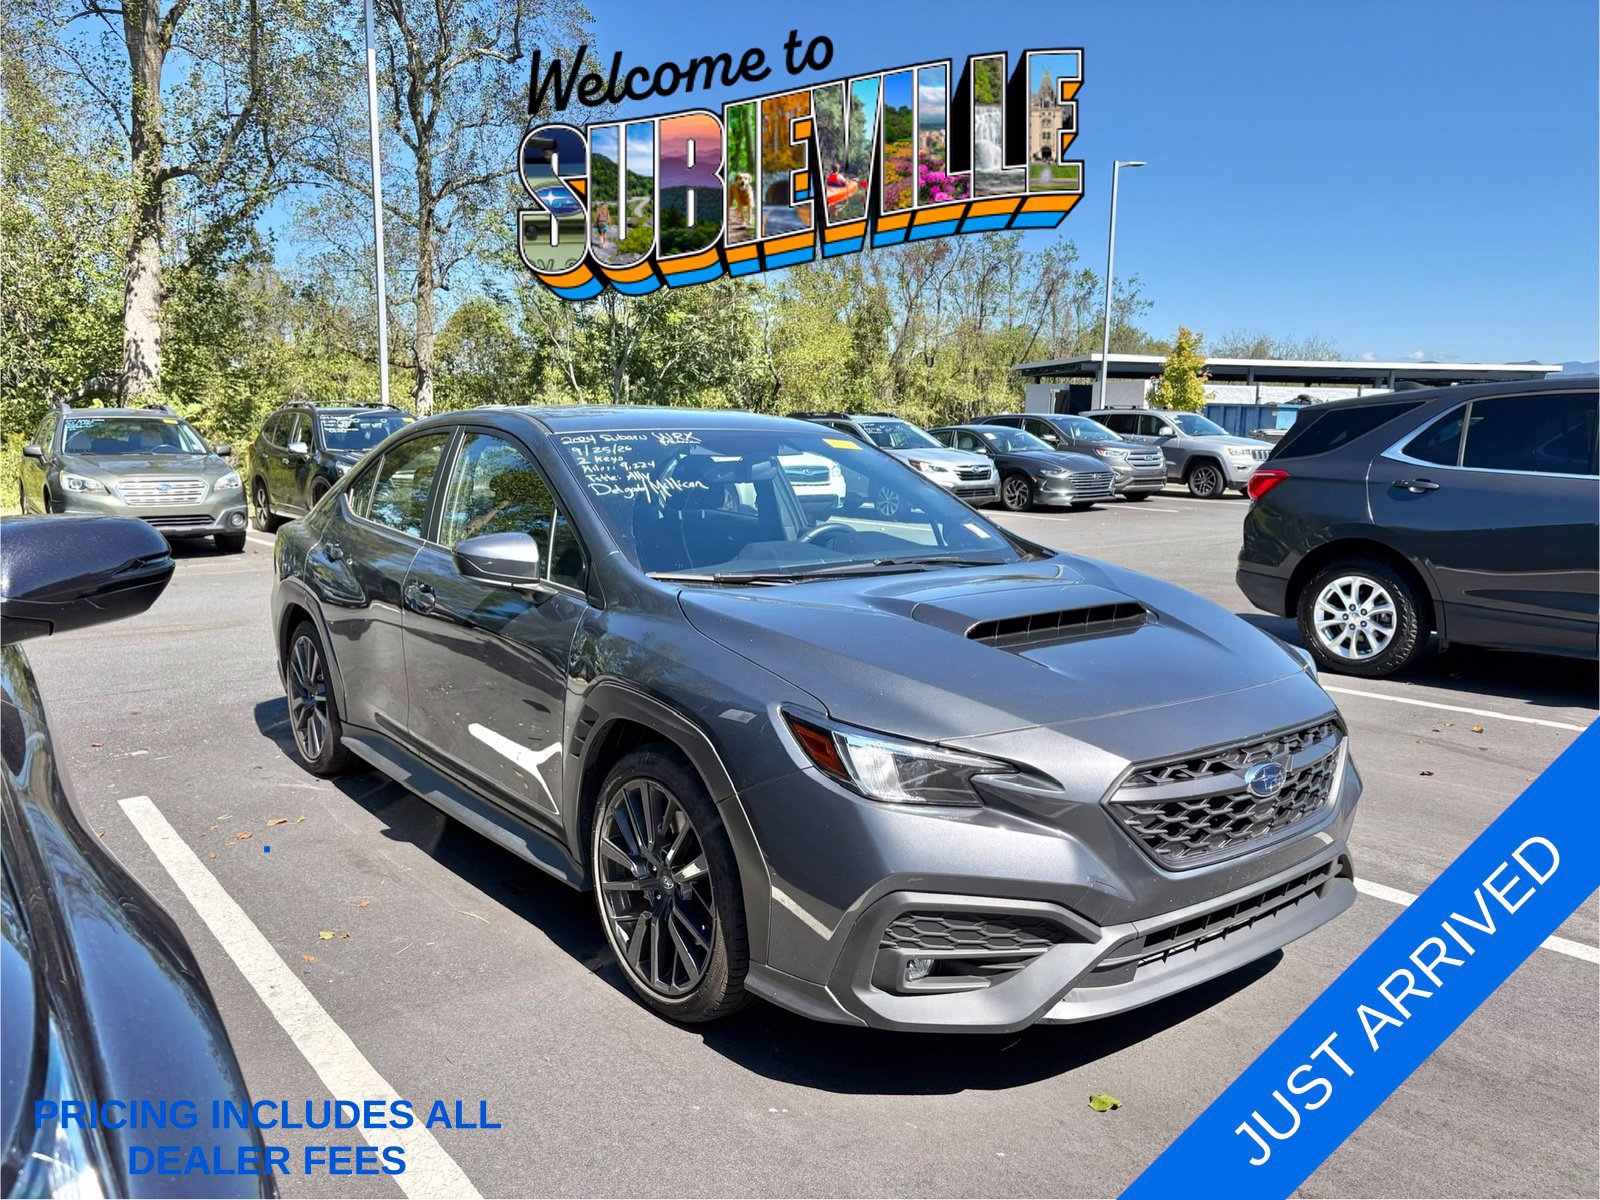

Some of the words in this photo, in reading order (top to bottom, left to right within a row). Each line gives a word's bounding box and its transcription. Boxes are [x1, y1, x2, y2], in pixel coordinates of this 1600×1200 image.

[561, 434, 597, 445] 2024
[599, 433, 648, 442] Subaru
[577, 457, 591, 465] 2
